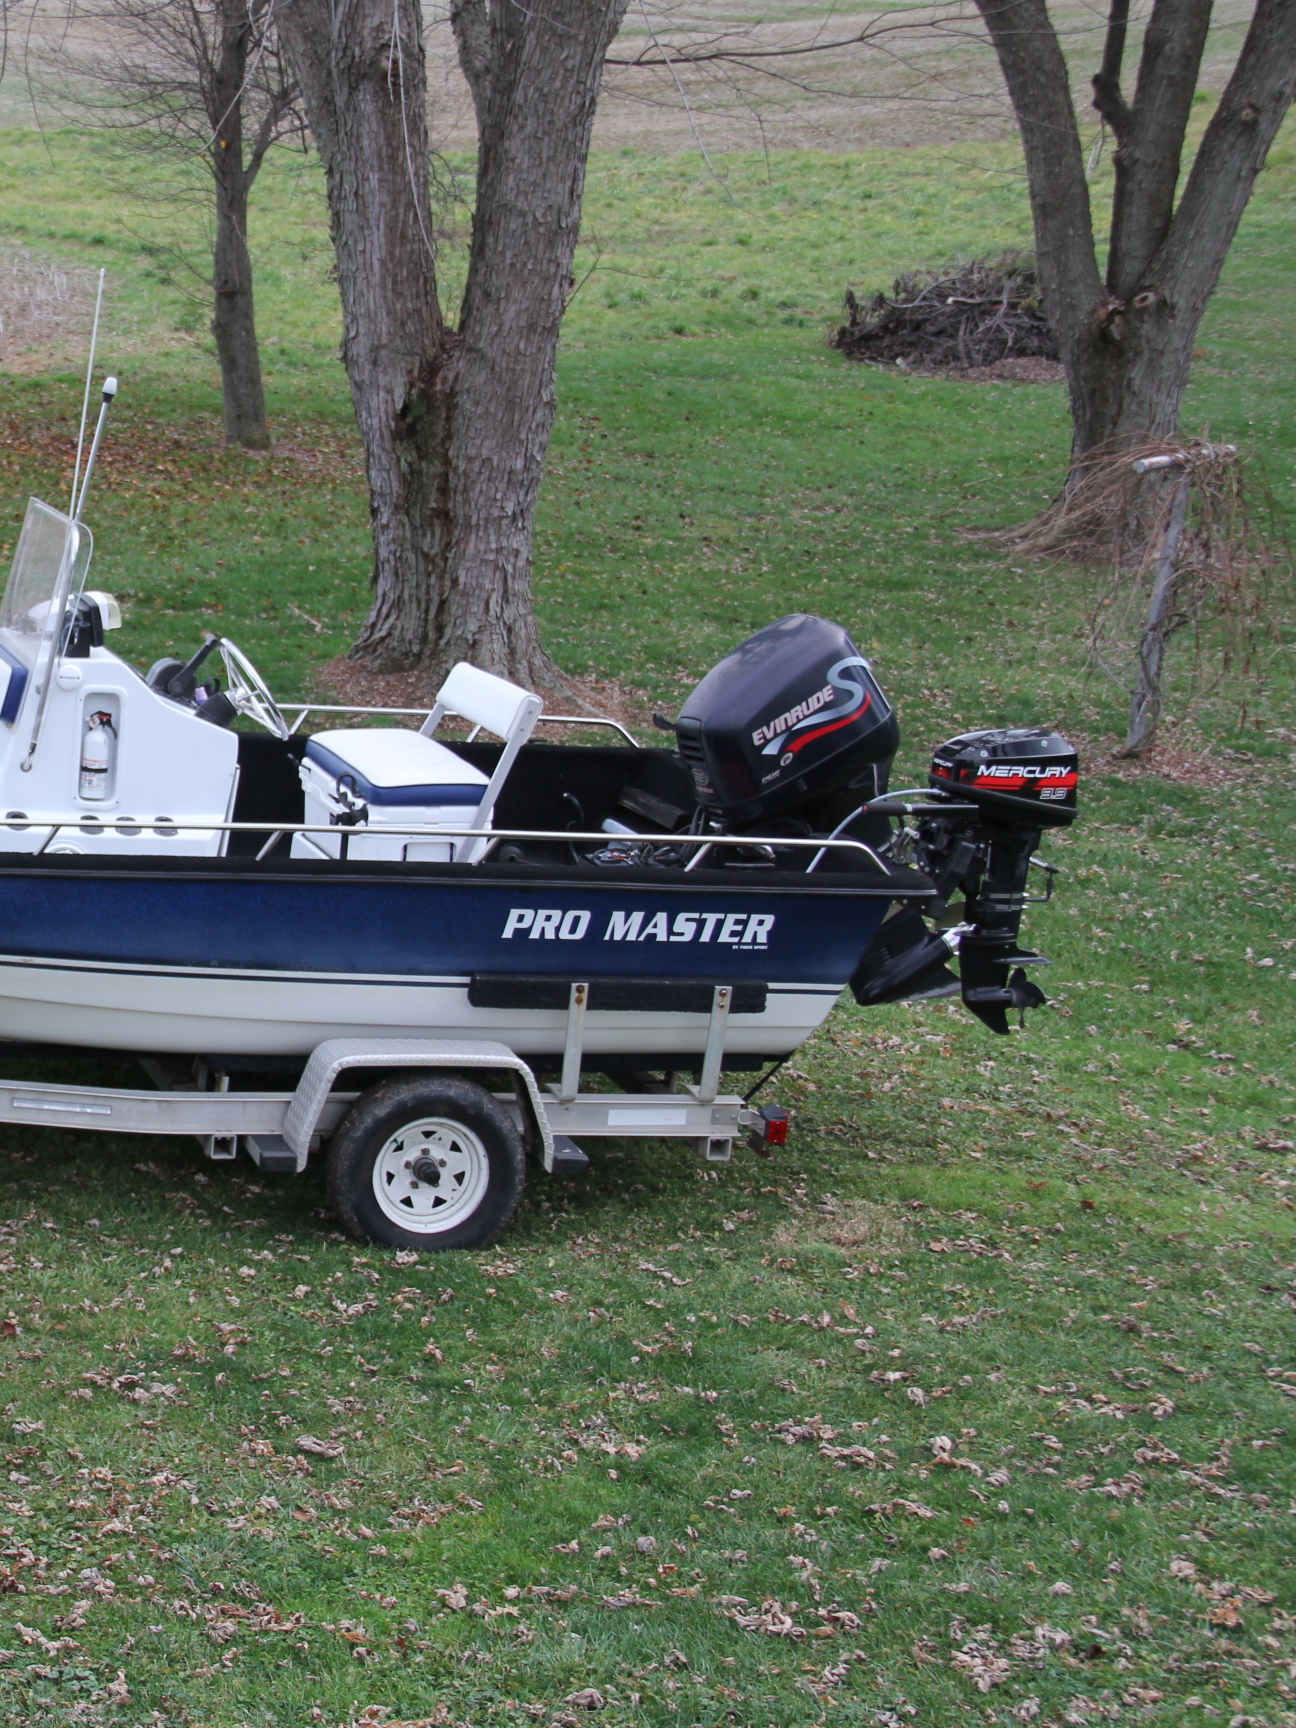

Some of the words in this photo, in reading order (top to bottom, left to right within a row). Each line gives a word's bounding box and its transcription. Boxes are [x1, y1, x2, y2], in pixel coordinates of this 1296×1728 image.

[751, 684, 835, 746] EVINRUDE
[933, 757, 954, 768] MERCURY
[977, 764, 1071, 778] MERCURY
[1039, 788, 1067, 800] 9.9
[501, 908, 592, 940] PRO
[603, 911, 776, 943] MASTER
